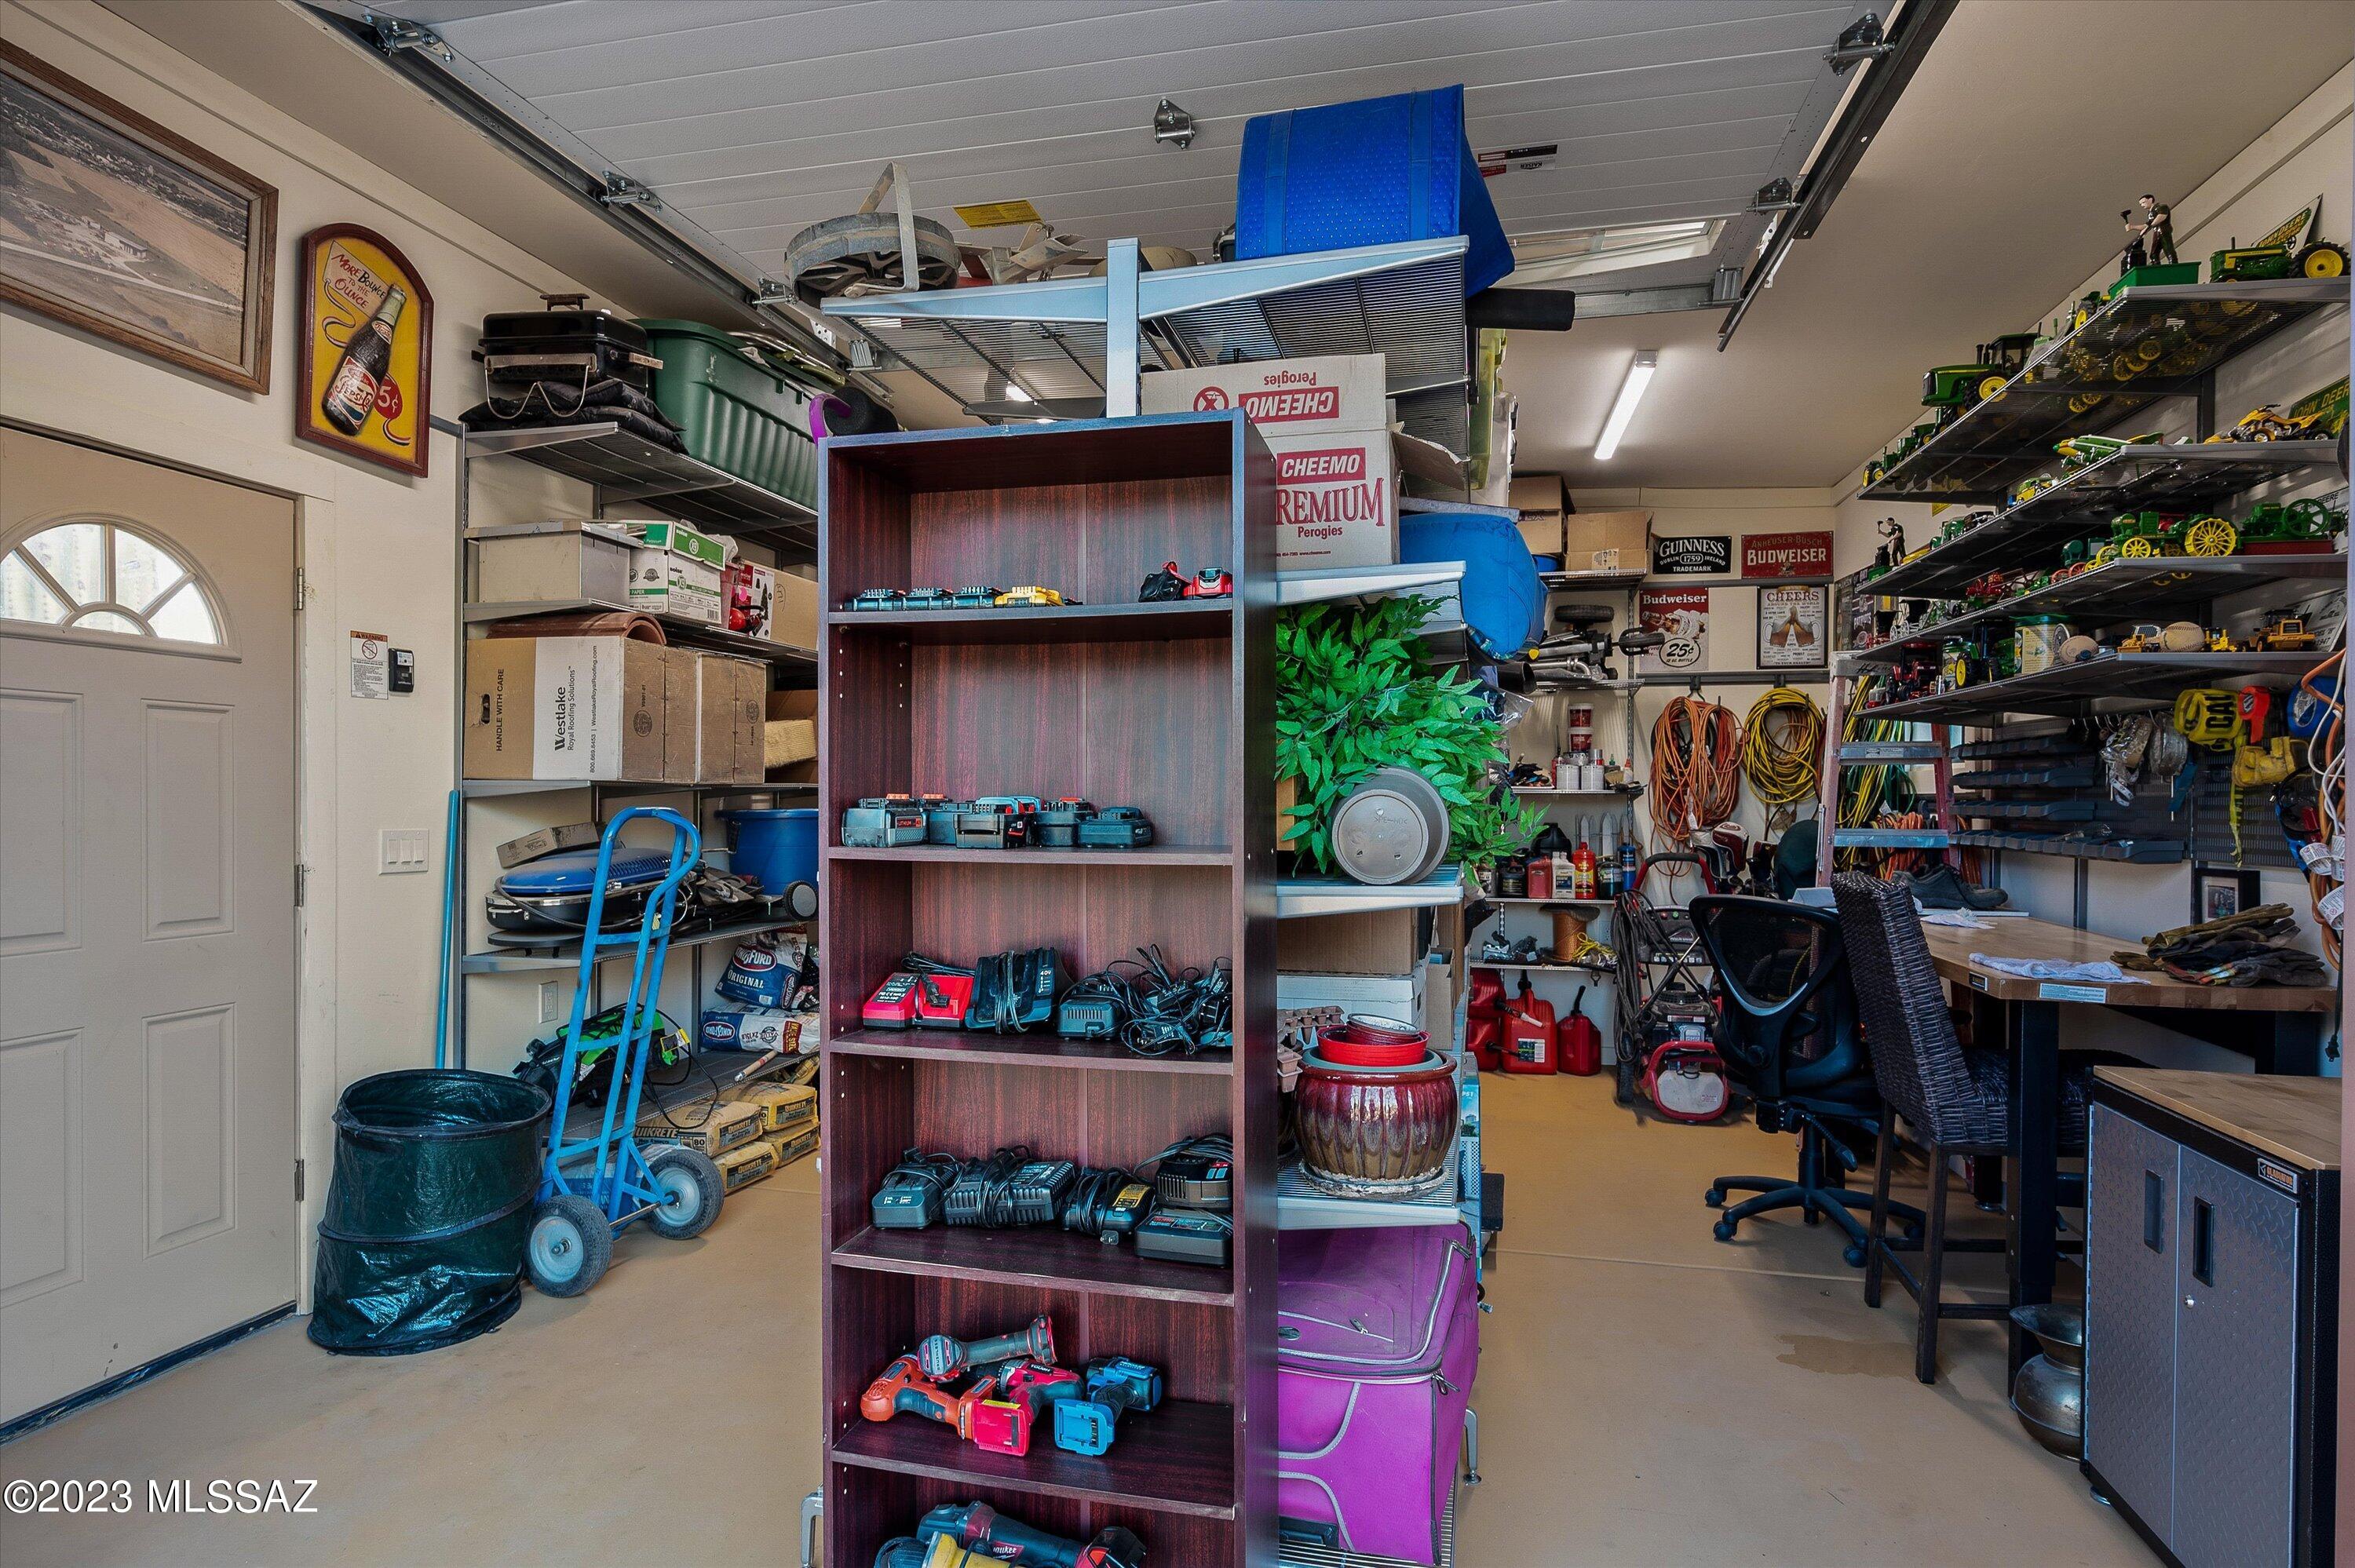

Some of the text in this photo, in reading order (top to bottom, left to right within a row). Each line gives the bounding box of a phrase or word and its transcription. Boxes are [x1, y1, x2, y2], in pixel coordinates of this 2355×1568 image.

[331, 253, 387, 299] MORE BOUNCE
[334, 278, 369, 309] OUNCE
[348, 276, 370, 297] TO THE
[1263, 370, 1317, 388] Perogies
[2321, 382, 2350, 406] DEER
[1245, 391, 1334, 418] CHEEMO
[1281, 454, 1360, 478] CHEEMO
[1276, 477, 1386, 527] REMIUM
[1297, 525, 1343, 540] Perogies
[1659, 538, 1725, 557] GUINNESS
[1659, 556, 1680, 566] DUBLIN
[1704, 555, 1726, 566] IRELAND
[1747, 549, 1827, 566] BUDWEISER
[1643, 594, 1707, 604] Budweiser
[1767, 591, 1819, 602] CHEERS
[1667, 643, 1695, 658] 25¢
[554, 687, 566, 751] Westlake
[568, 703, 576, 731] Roofing
[568, 731, 576, 751] Royal
[728, 969, 764, 989] ORIGINAL
[785, 1101, 806, 1112] QUIKRETE
[636, 1127, 678, 1138] UIKRETE
[728, 1119, 751, 1134] QUIKRETE
[790, 1133, 811, 1147] QUIKRETE
[738, 1159, 761, 1173] QUIKRETE
